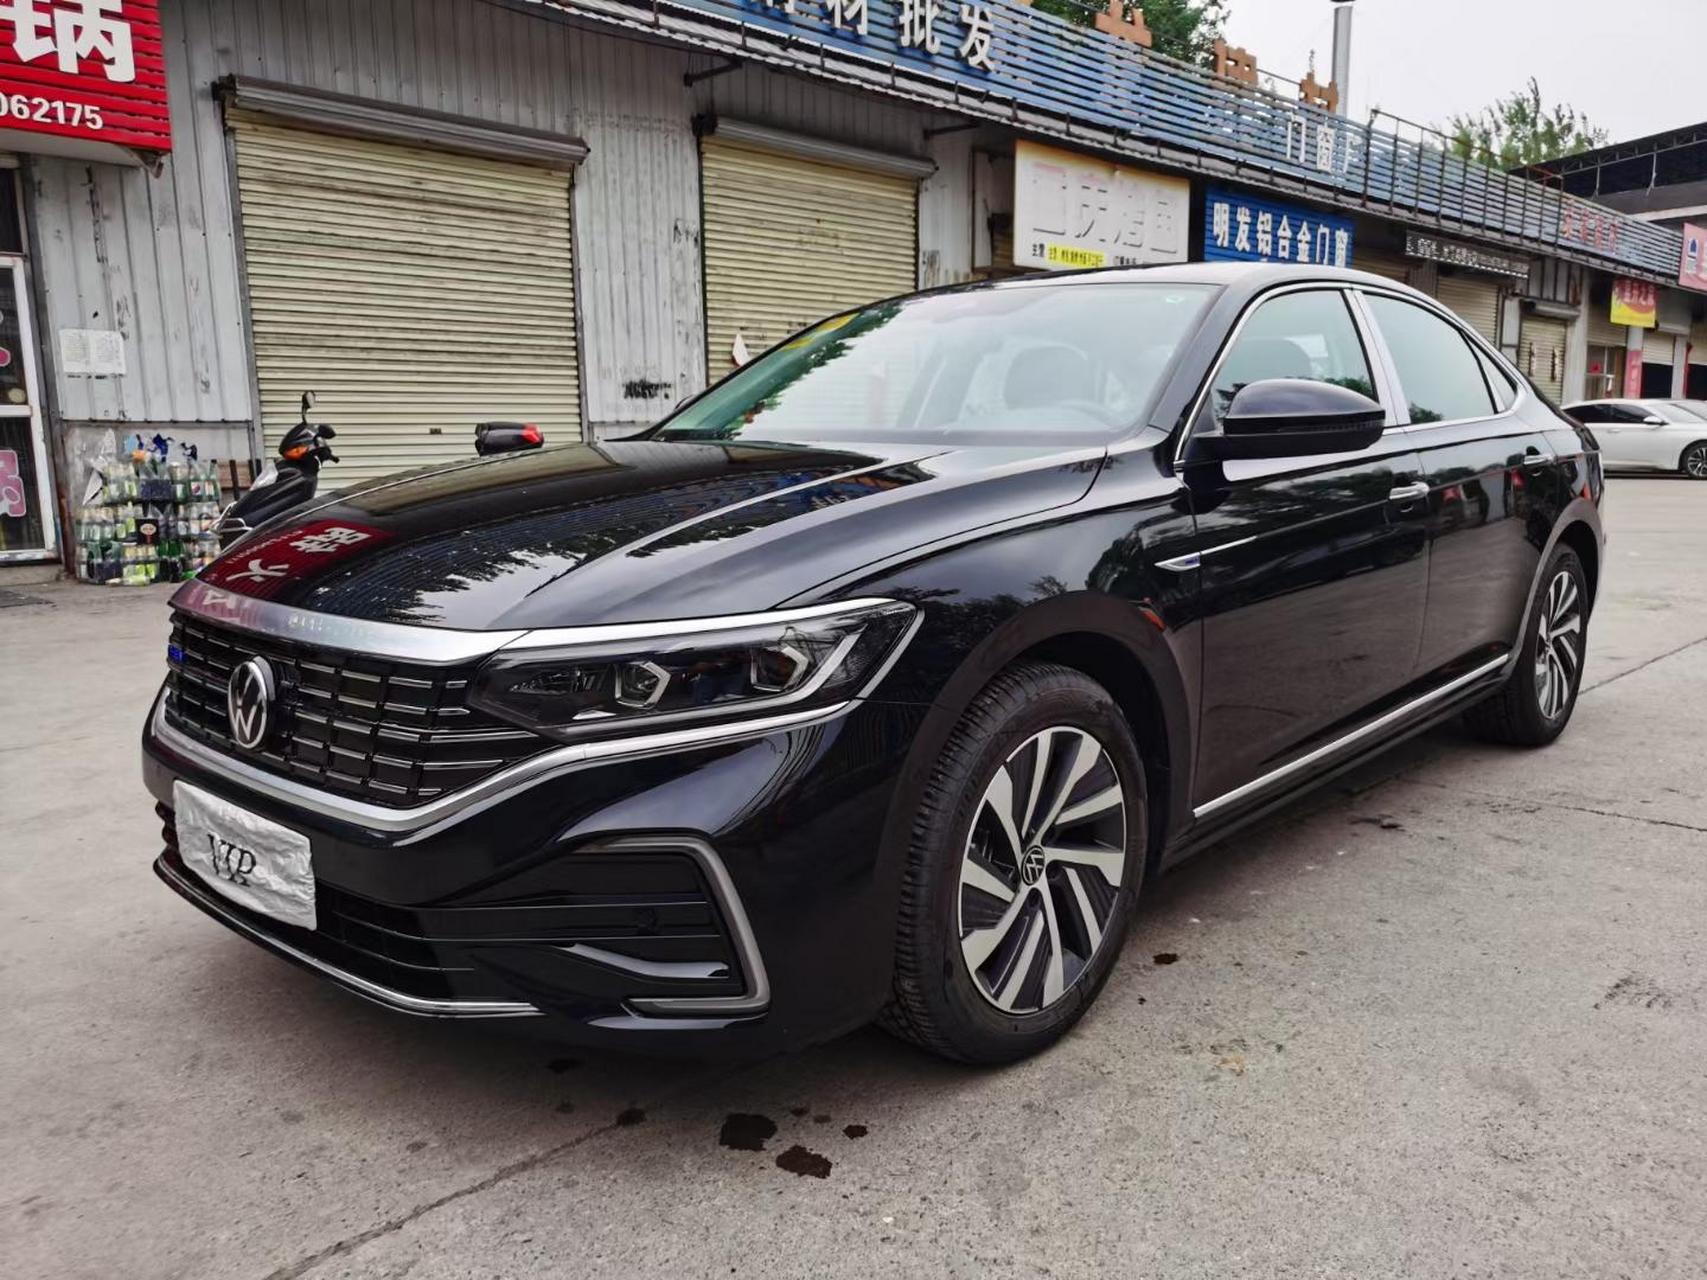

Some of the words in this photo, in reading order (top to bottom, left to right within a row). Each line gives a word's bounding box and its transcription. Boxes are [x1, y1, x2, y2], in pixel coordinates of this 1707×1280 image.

[765, 0, 1000, 73] 材批发
[1213, 202, 1349, 267] 明发铝合金门窗
